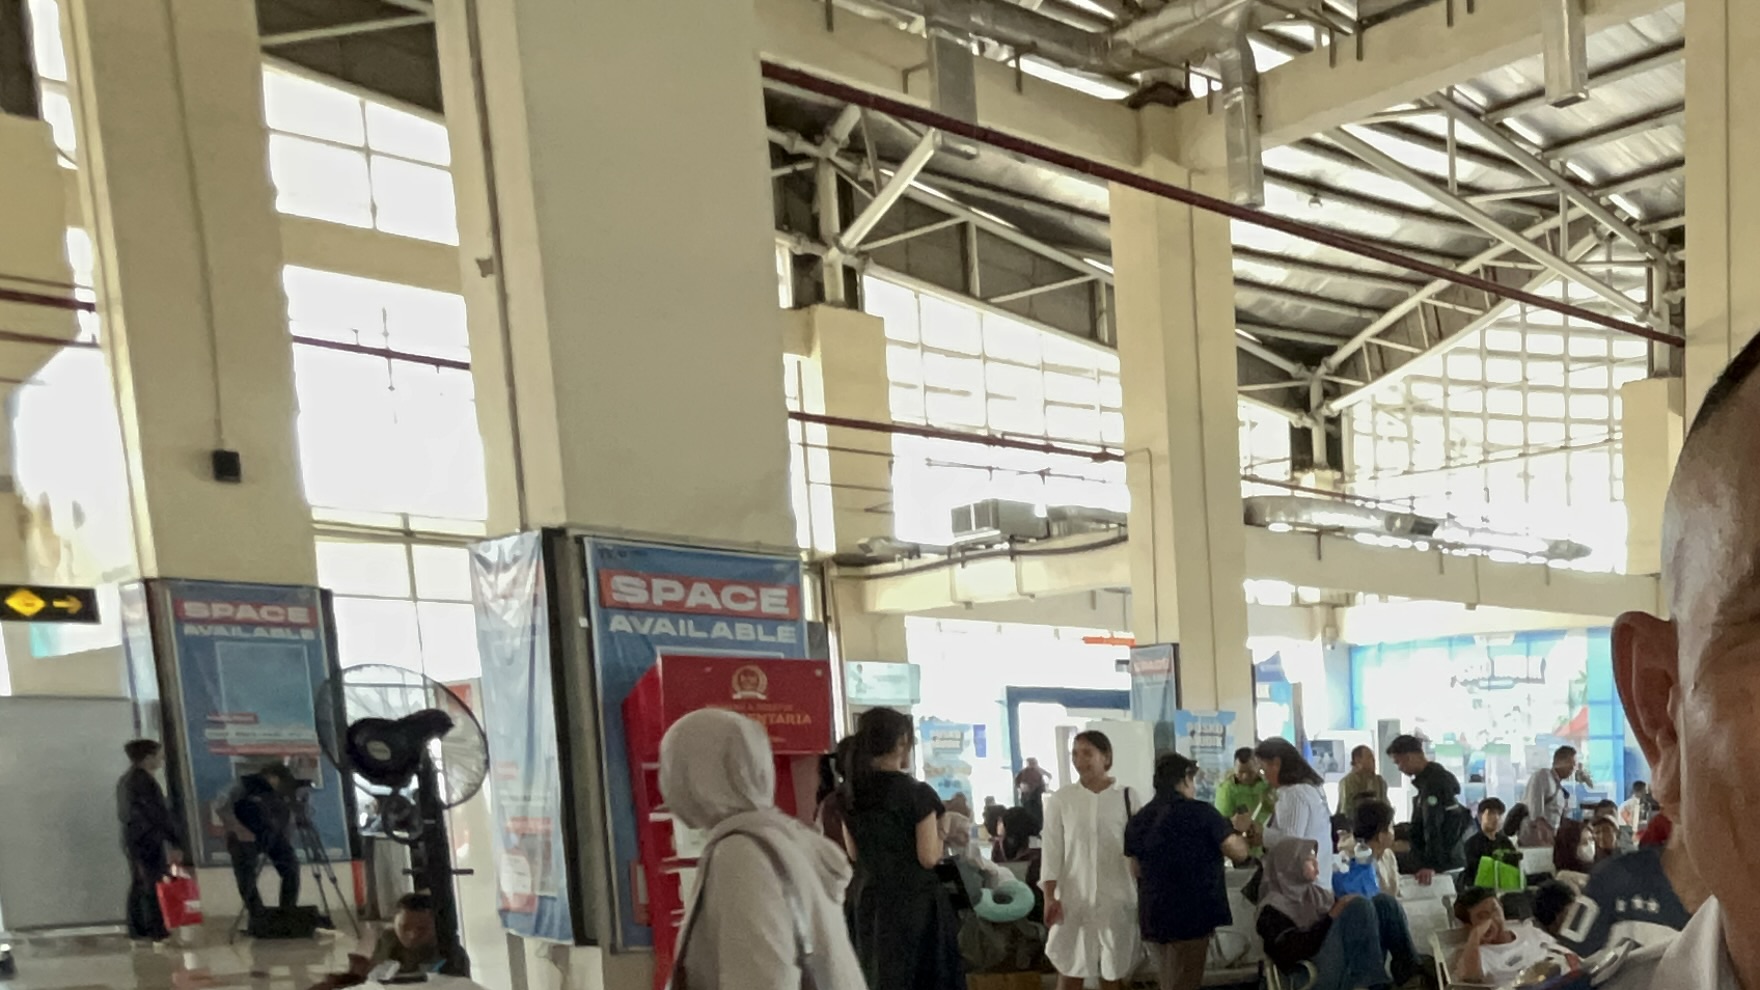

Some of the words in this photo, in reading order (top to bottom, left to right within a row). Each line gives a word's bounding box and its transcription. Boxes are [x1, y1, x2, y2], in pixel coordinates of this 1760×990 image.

[611, 575, 790, 615] SPACE
[183, 602, 310, 624] SPACE
[609, 614, 797, 644] AVAILABLE
